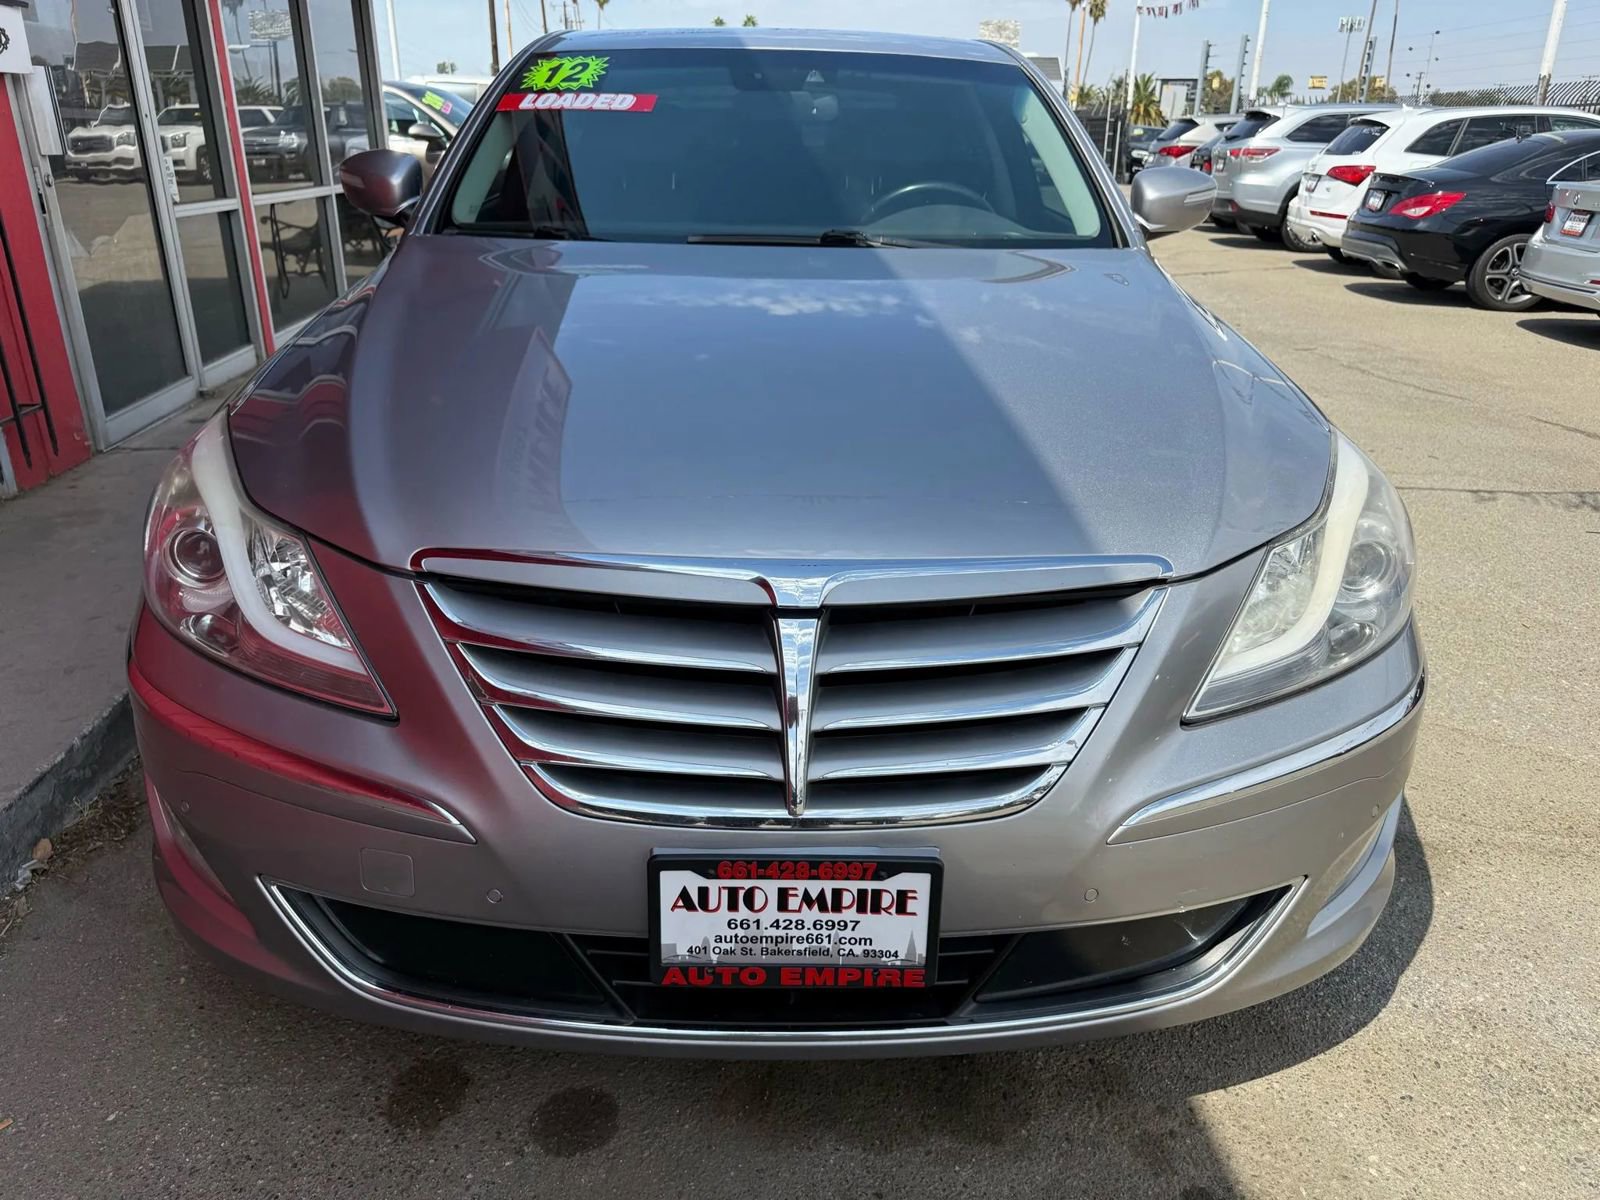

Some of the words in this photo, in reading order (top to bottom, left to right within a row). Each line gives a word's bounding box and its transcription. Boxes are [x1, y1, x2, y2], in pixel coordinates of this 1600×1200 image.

[544, 62, 590, 83] 12
[518, 93, 637, 110] LOADED
[717, 860, 877, 880] 661-428-6997
[670, 885, 768, 913] AUTO
[777, 886, 918, 916] EMPIRE
[727, 918, 861, 932] 661.428.6997
[714, 933, 873, 947] autoempire661.com
[687, 945, 708, 955] 401
[712, 946, 736, 956] Oak
[740, 947, 757, 957] St.
[760, 946, 833, 958] Bakersfield,
[837, 948, 859, 958] CA.
[863, 949, 899, 959] 93304
[661, 967, 767, 987] AUTO
[780, 968, 926, 988] EMPIRE
